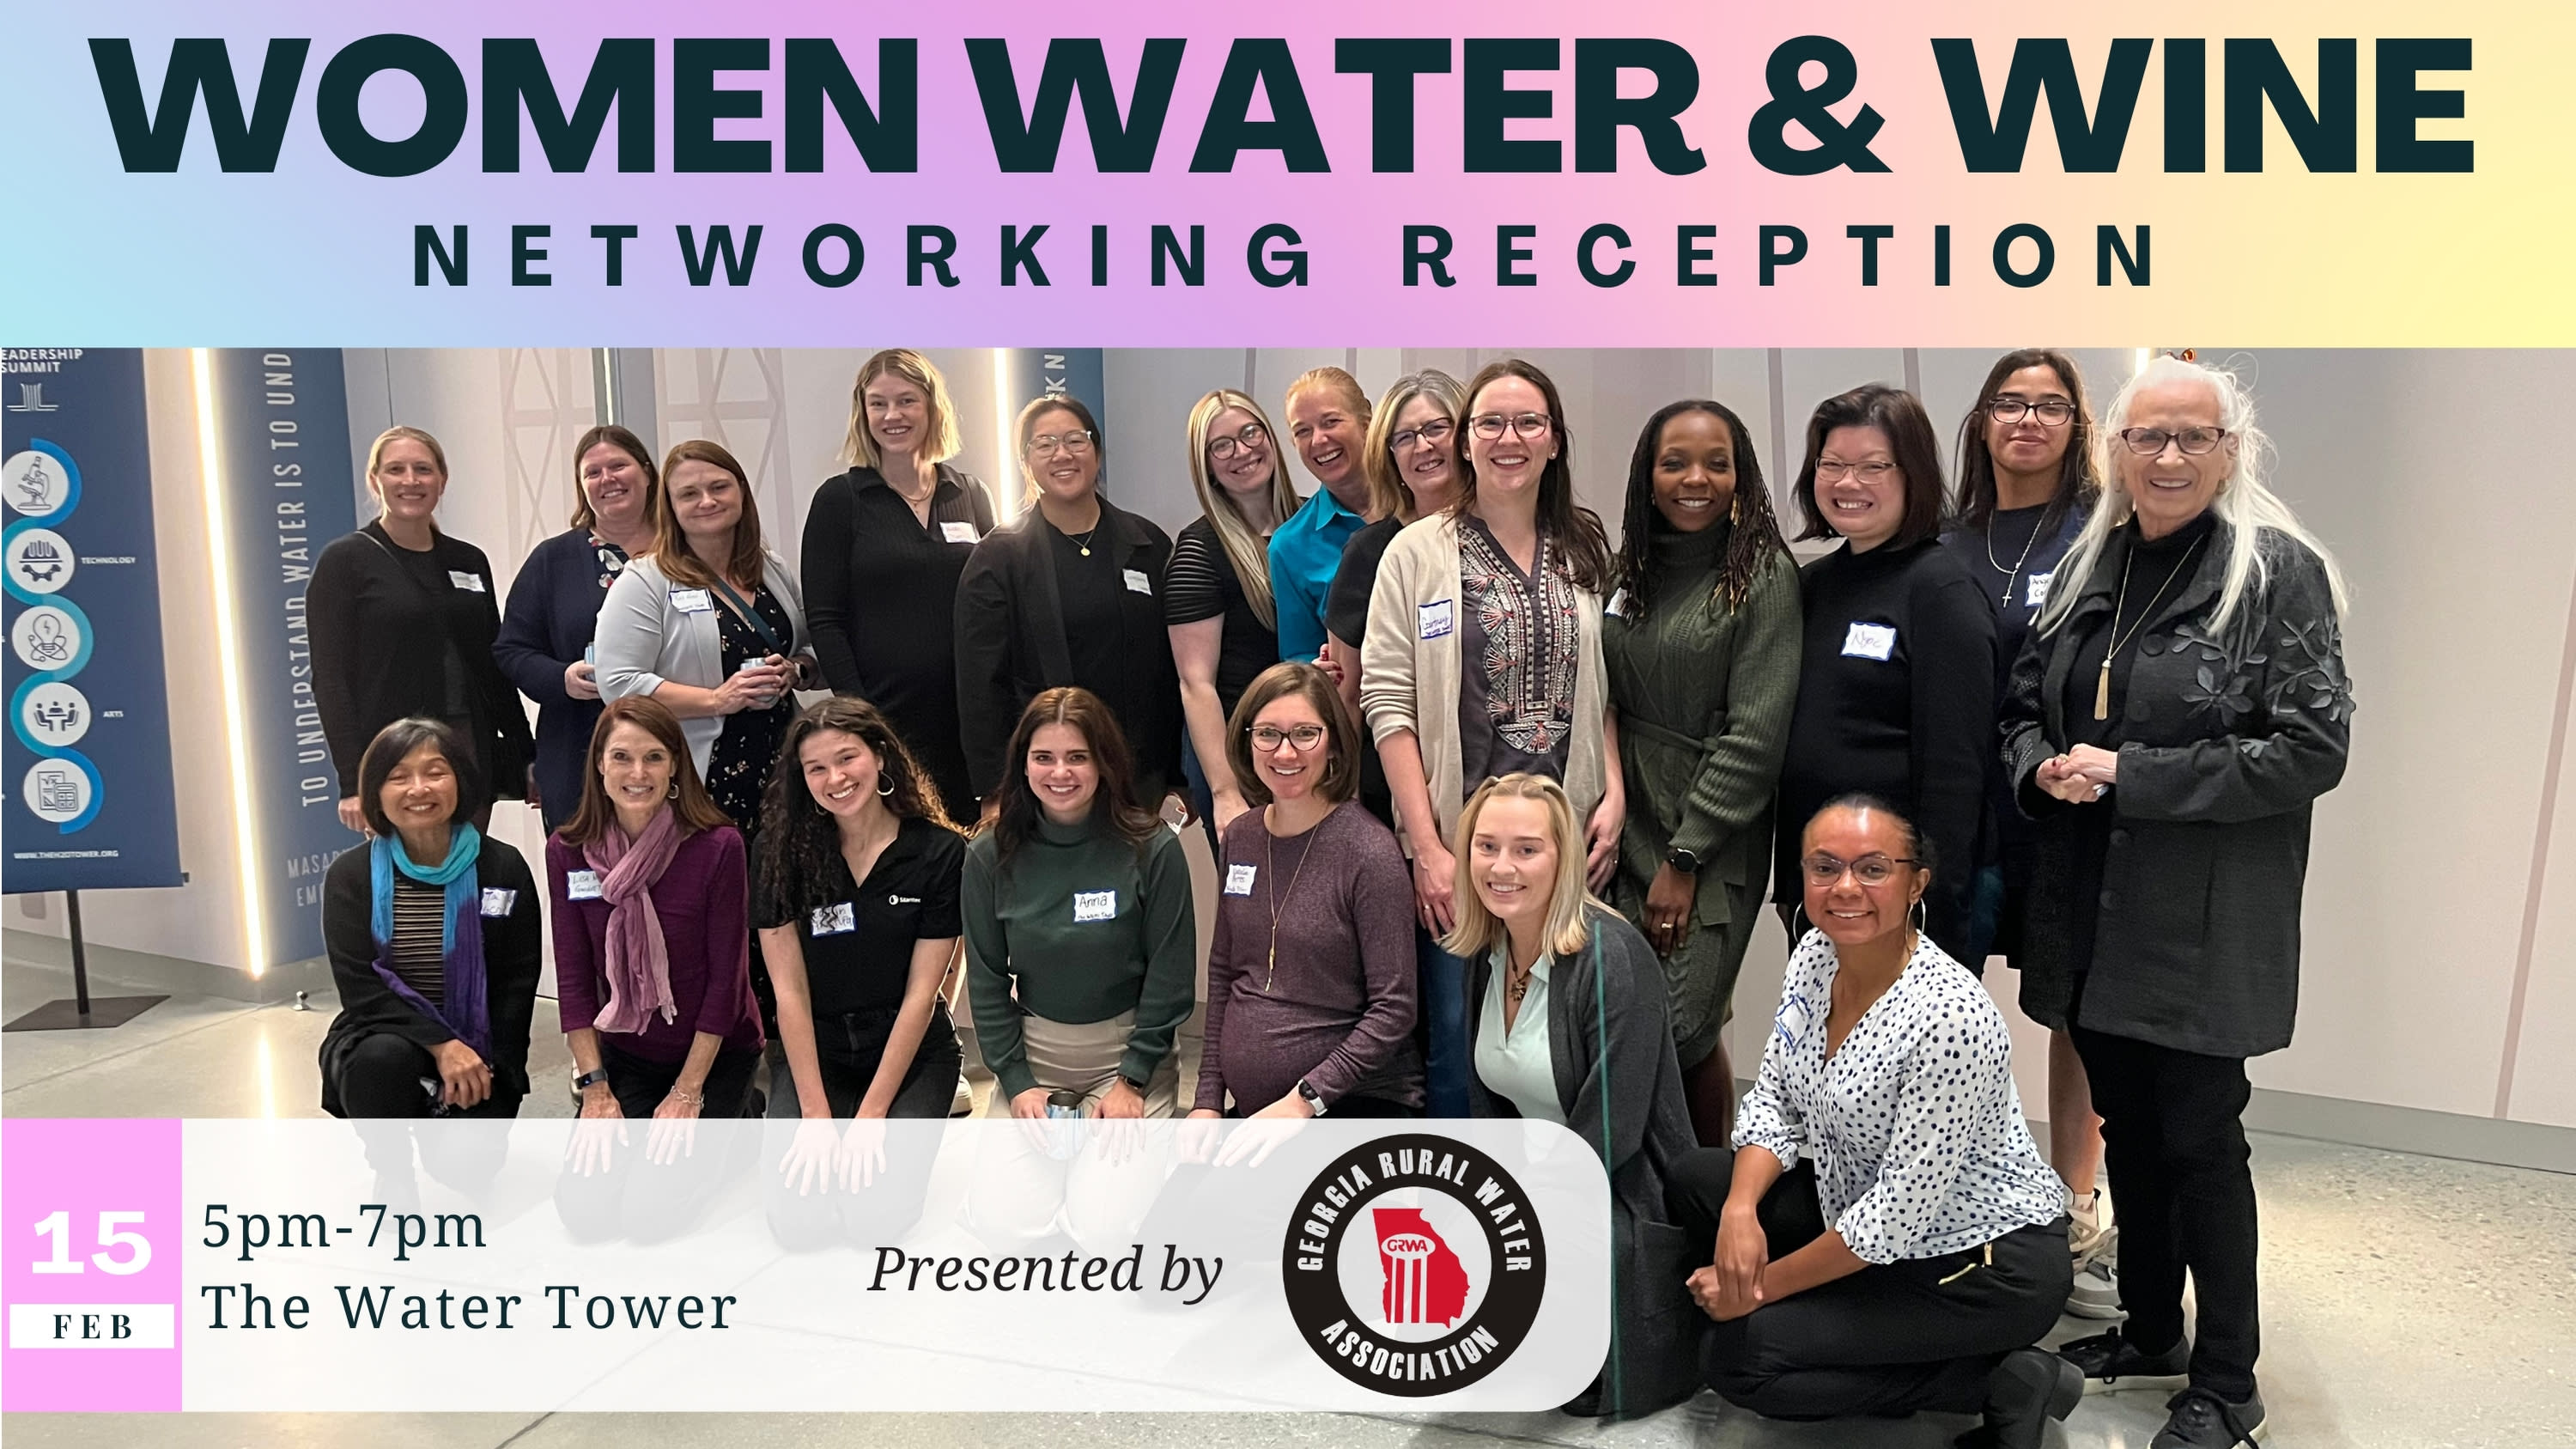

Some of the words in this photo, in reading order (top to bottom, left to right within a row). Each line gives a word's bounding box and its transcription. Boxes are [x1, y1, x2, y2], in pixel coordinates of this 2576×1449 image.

[2, 362, 60, 373] SUMMIT
[269, 420, 299, 450] TO
[272, 464, 302, 487] IS
[276, 502, 311, 583] WATER
[301, 776, 330, 807] TO
[1078, 895, 1108, 908] Anna
